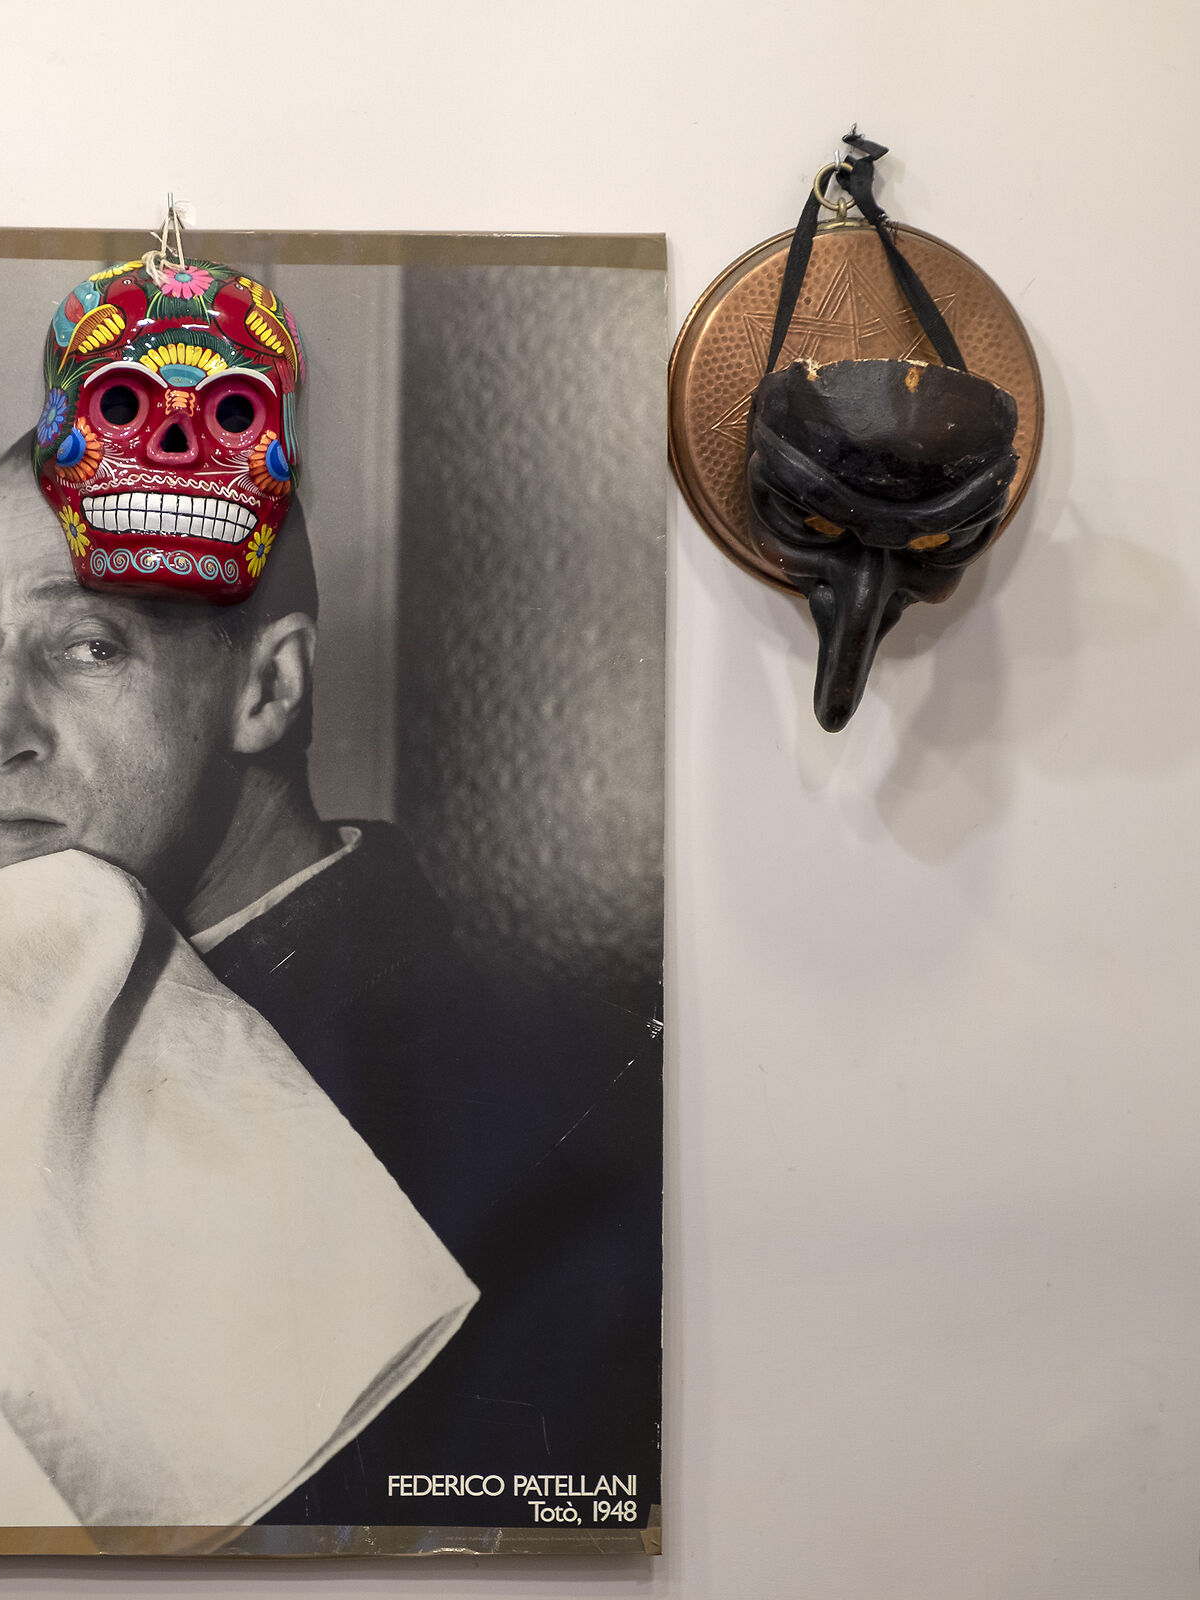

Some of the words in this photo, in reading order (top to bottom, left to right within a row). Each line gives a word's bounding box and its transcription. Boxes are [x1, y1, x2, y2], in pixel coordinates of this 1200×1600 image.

[388, 1474, 505, 1497] FEDERICO
[513, 1474, 637, 1497] PATELLANI
[528, 1500, 582, 1526] Totò,
[593, 1500, 638, 1522] 1948
